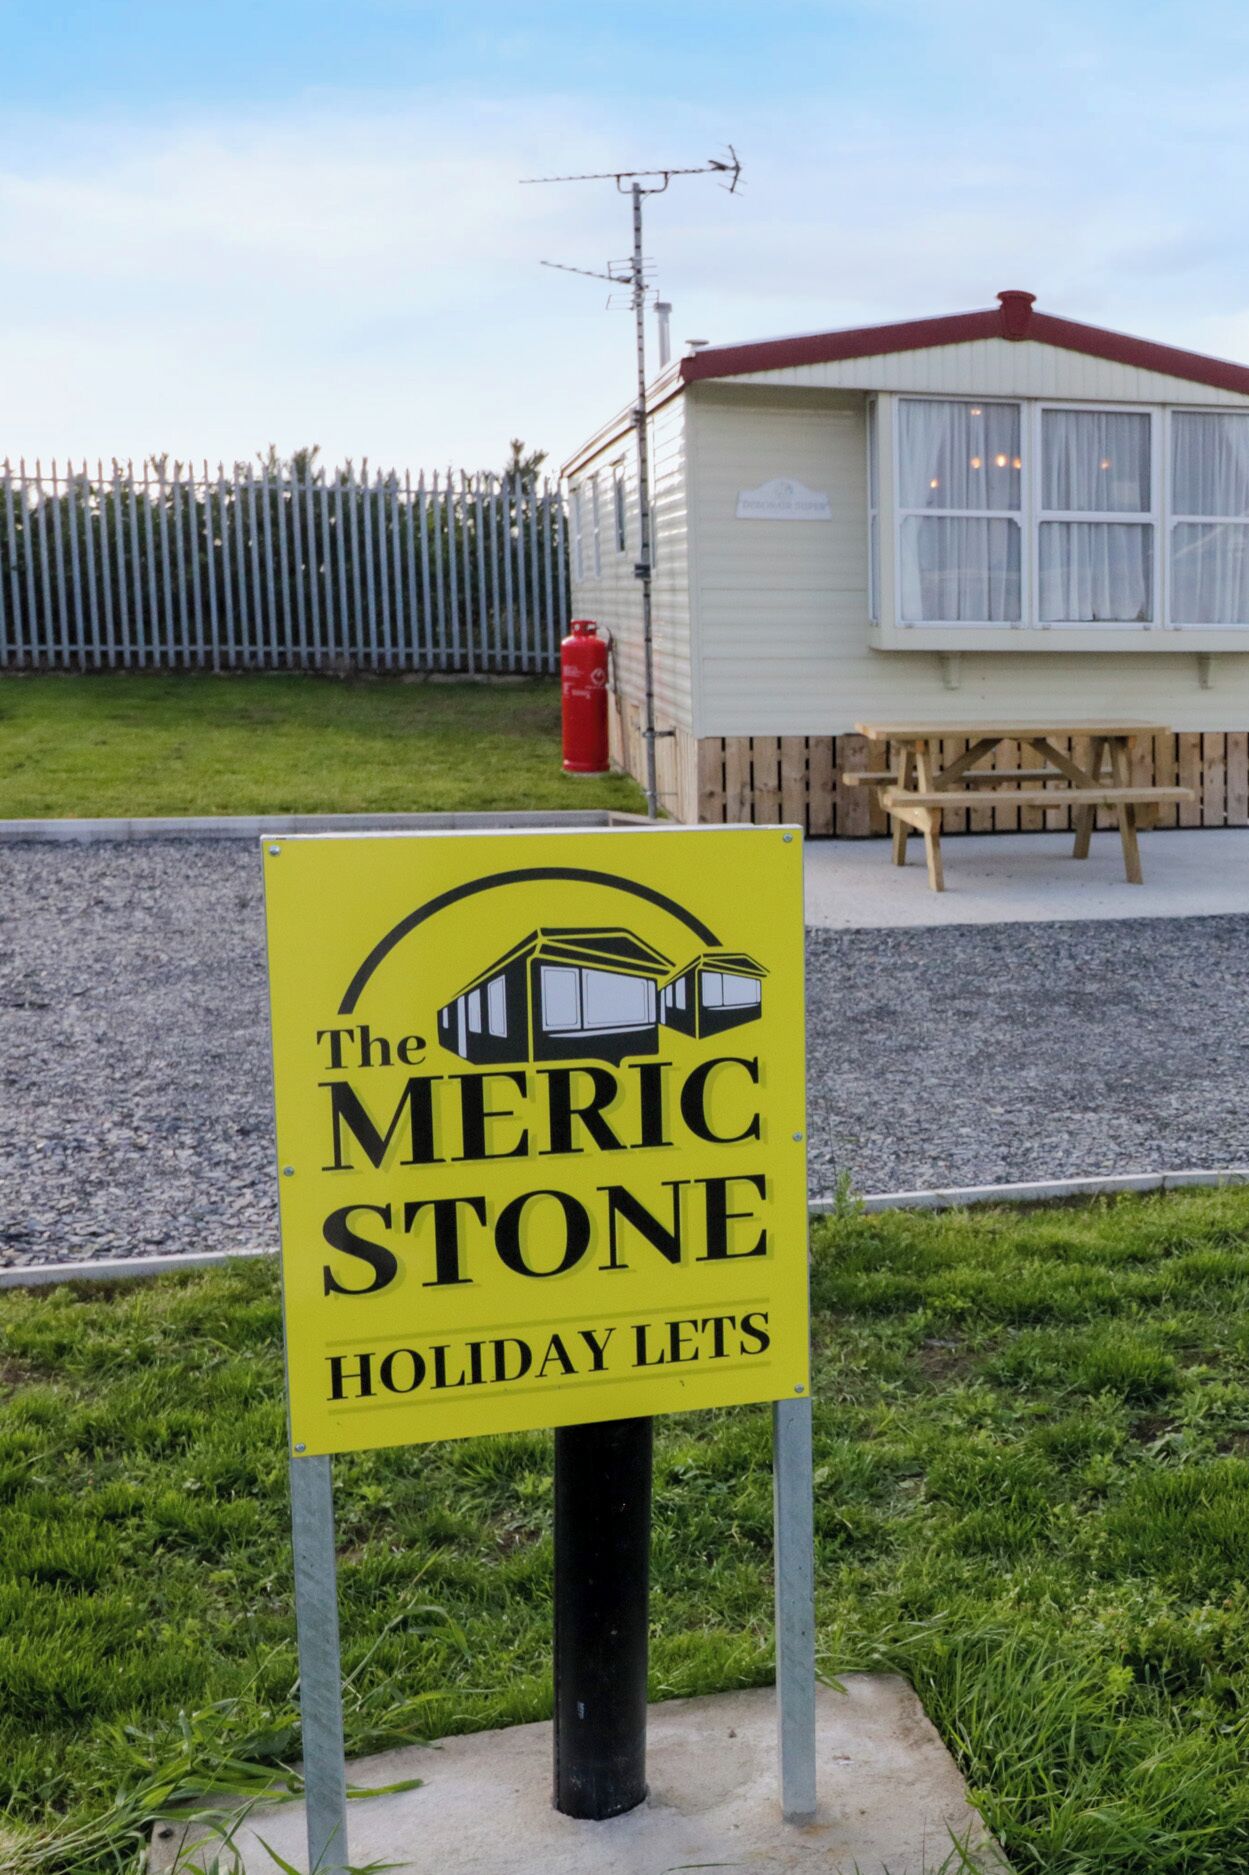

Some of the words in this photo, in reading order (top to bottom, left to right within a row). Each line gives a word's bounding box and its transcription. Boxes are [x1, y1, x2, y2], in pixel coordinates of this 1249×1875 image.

[317, 1025, 426, 1070] The
[318, 1056, 763, 1173] MERIC
[323, 1173, 768, 1298] STONE
[325, 1327, 615, 1402] HOLIDAY
[631, 1311, 770, 1368] LETS
